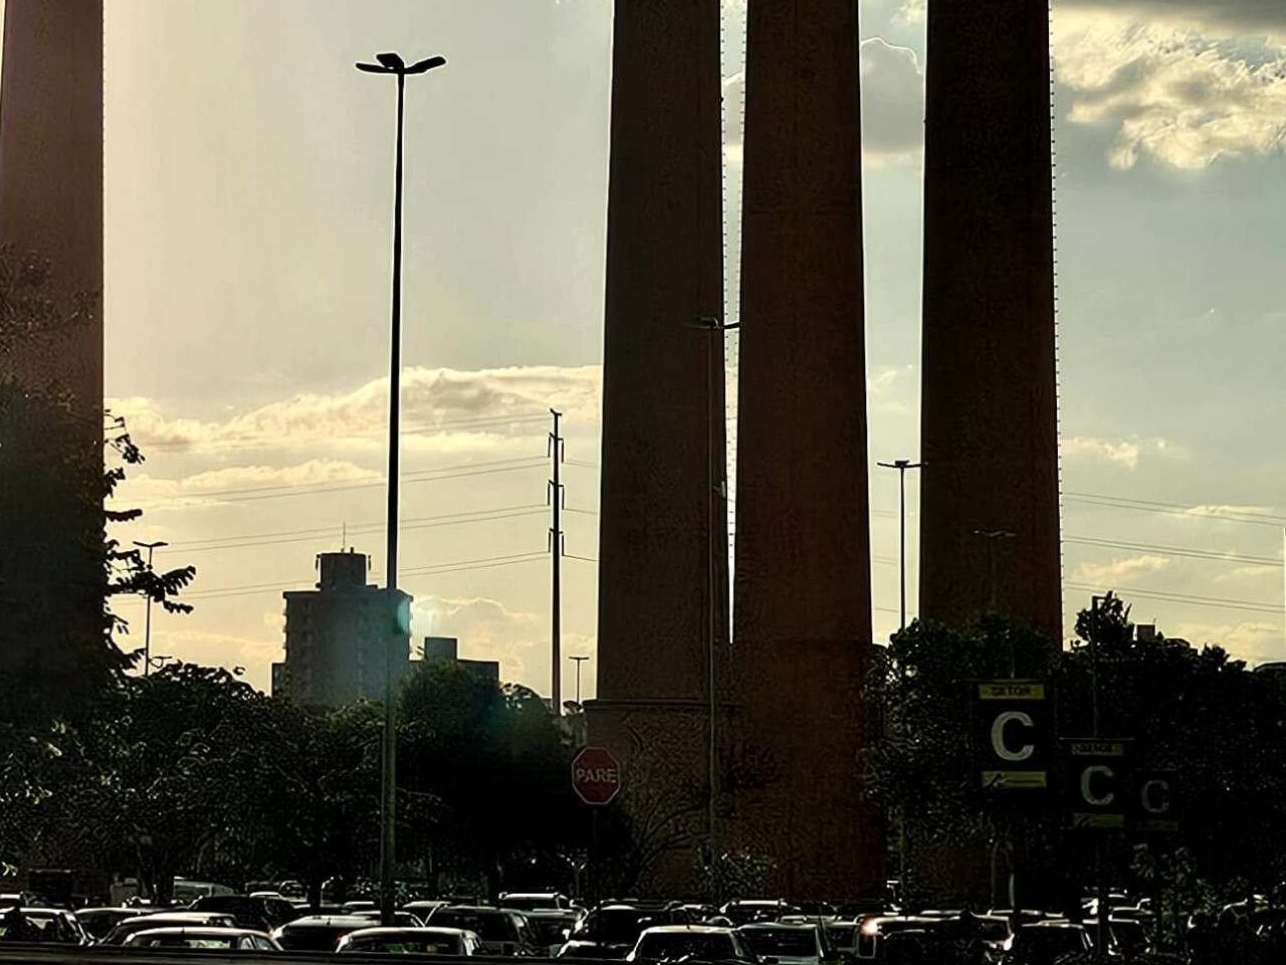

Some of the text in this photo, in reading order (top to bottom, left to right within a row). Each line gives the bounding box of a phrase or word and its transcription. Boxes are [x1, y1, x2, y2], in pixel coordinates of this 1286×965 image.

[990, 711, 1034, 761] C
[576, 767, 617, 784] PARE
[1081, 765, 1114, 805] C
